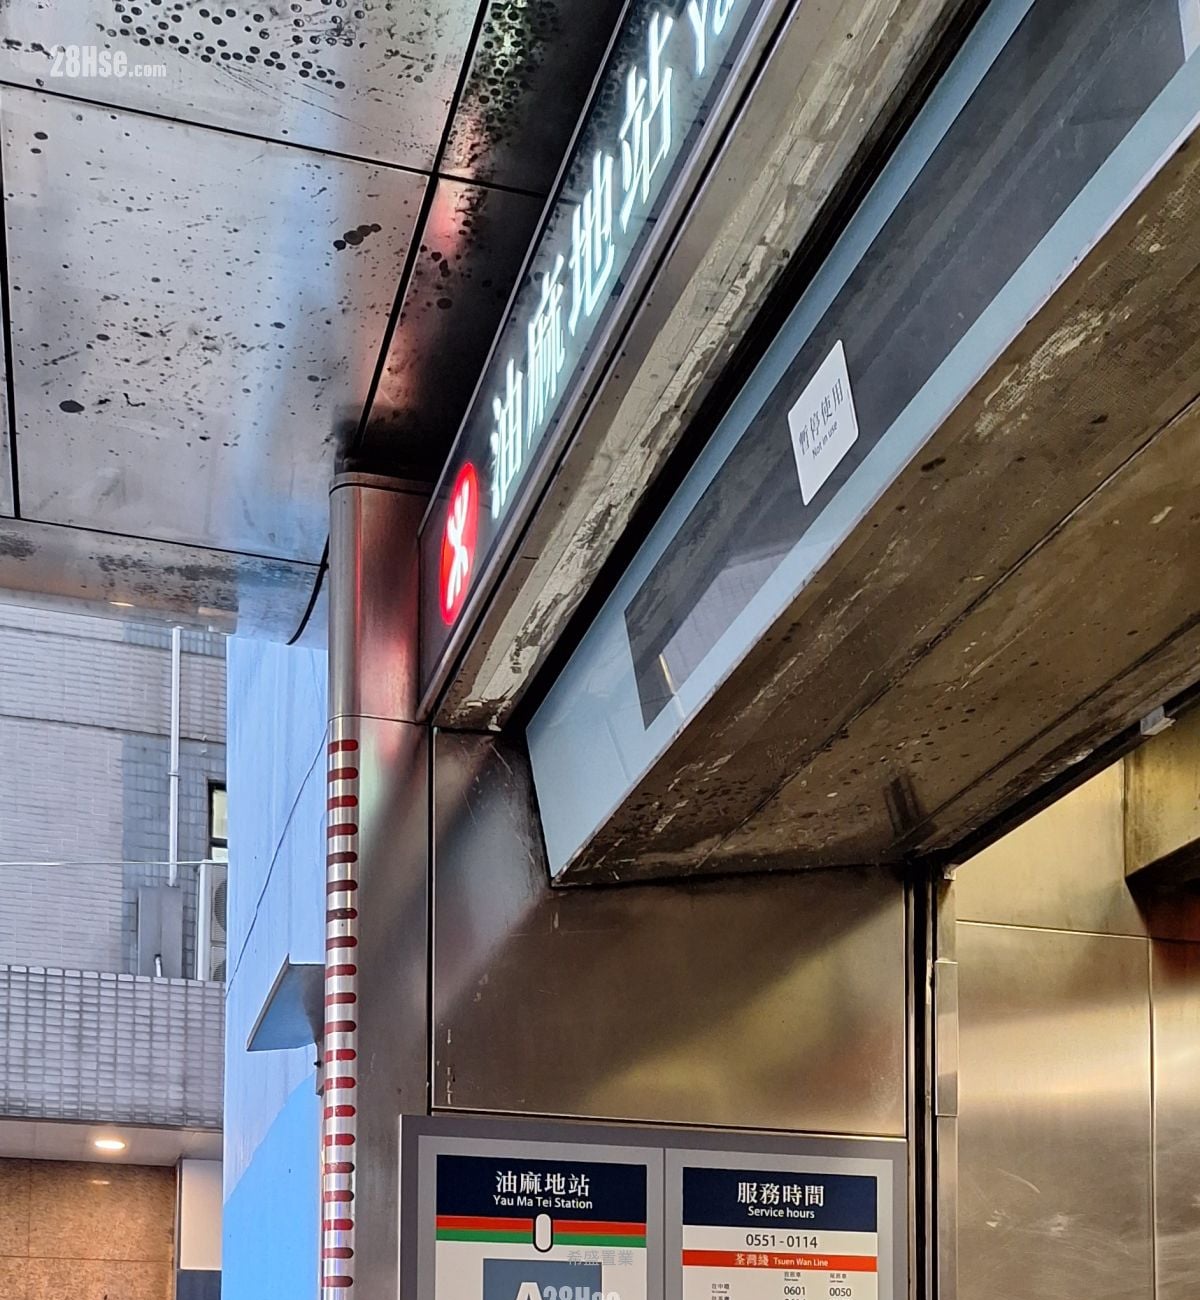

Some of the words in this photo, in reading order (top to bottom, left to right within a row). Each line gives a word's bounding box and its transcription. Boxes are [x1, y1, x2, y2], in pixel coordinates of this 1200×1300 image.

[490, 10, 674, 520] 油麻地站
[812, 441, 823, 459] Not
[822, 433, 830, 447] in
[828, 421, 838, 439] use
[495, 1170, 590, 1197] 油麻地站
[493, 1194, 514, 1206] Yau
[516, 1196, 533, 1207] Ma
[535, 1196, 552, 1208] Tei
[554, 1197, 593, 1209] Station
[737, 1182, 825, 1207] 服務時間
[748, 1206, 785, 1218] Service
[786, 1207, 815, 1219] hours
[745, 1233, 776, 1247] 0551
[786, 1235, 818, 1249] 0114
[774, 1256, 795, 1266] Tsuen
[796, 1257, 813, 1266] Wan
[813, 1258, 829, 1267] Line
[784, 1286, 806, 1296] 0601
[829, 1287, 852, 1297] 0050
